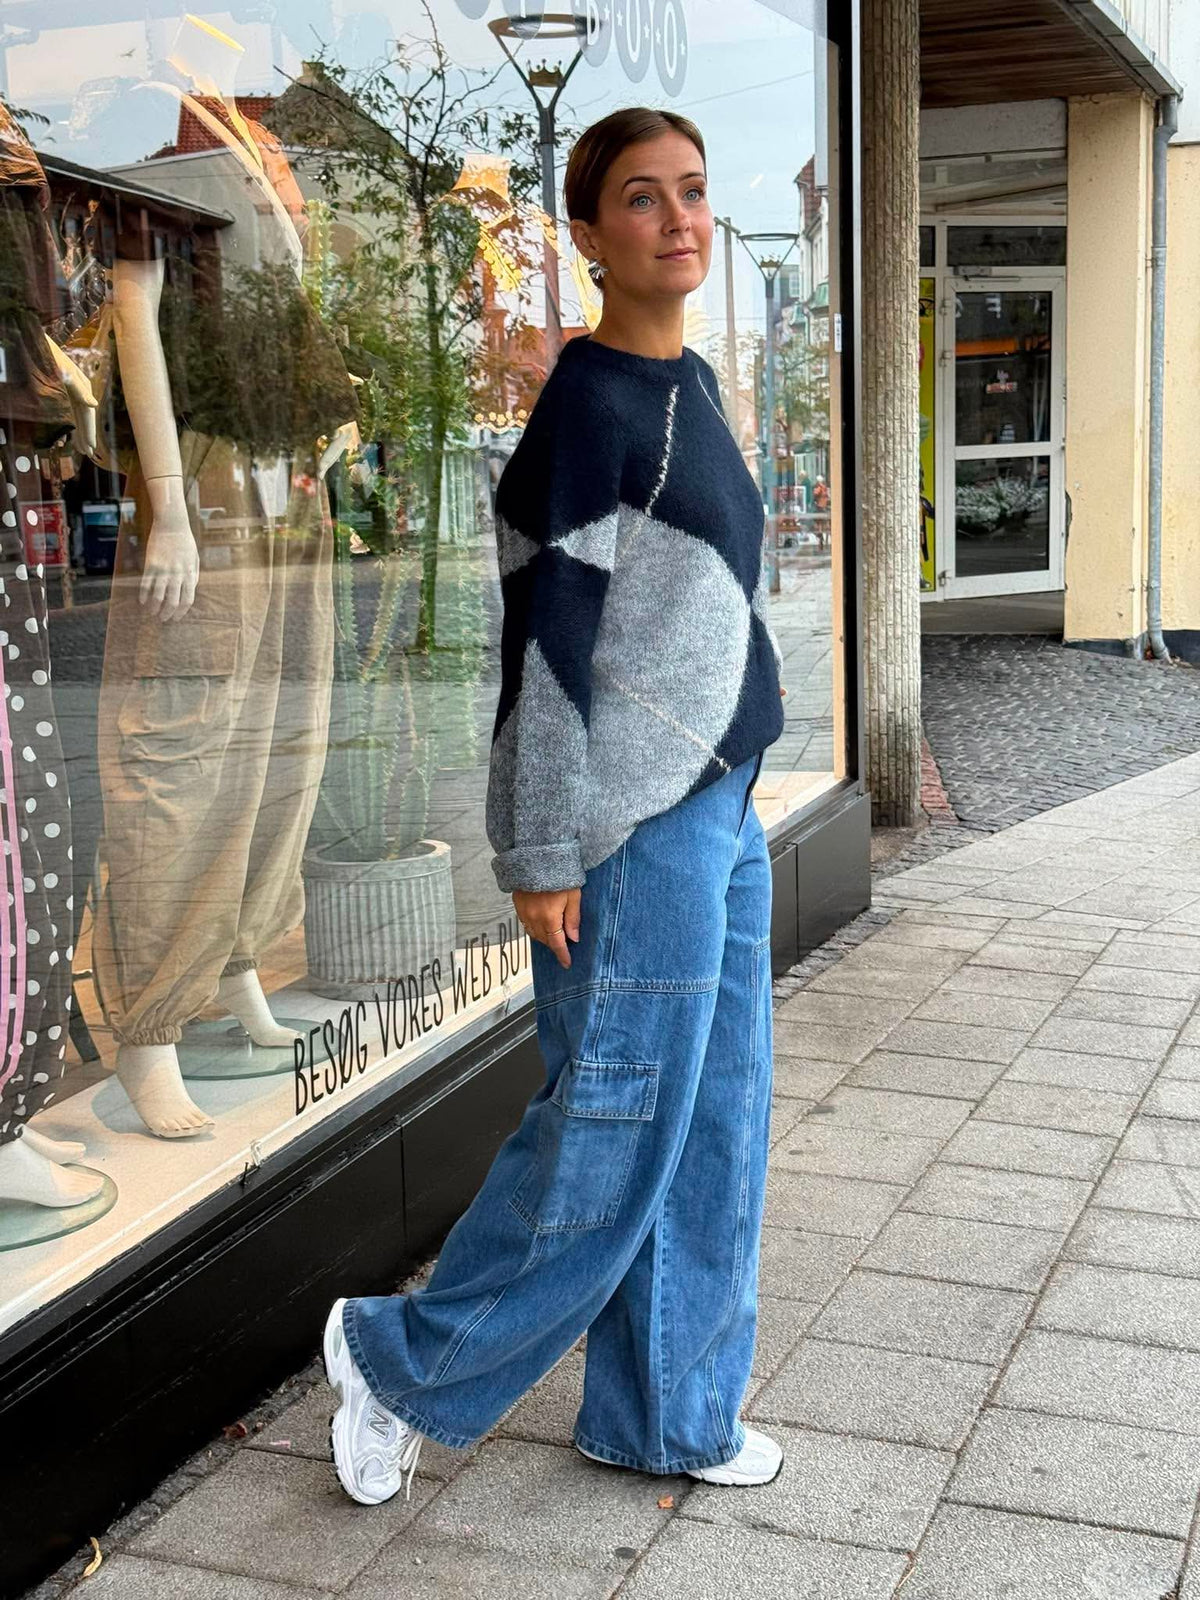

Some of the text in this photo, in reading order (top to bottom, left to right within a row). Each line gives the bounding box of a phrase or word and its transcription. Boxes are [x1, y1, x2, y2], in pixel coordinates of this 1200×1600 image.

[293, 1000, 368, 1116] BESØG
[374, 958, 444, 1057] VORES
[450, 932, 491, 1015] WEB
[367, 1406, 392, 1439] N
